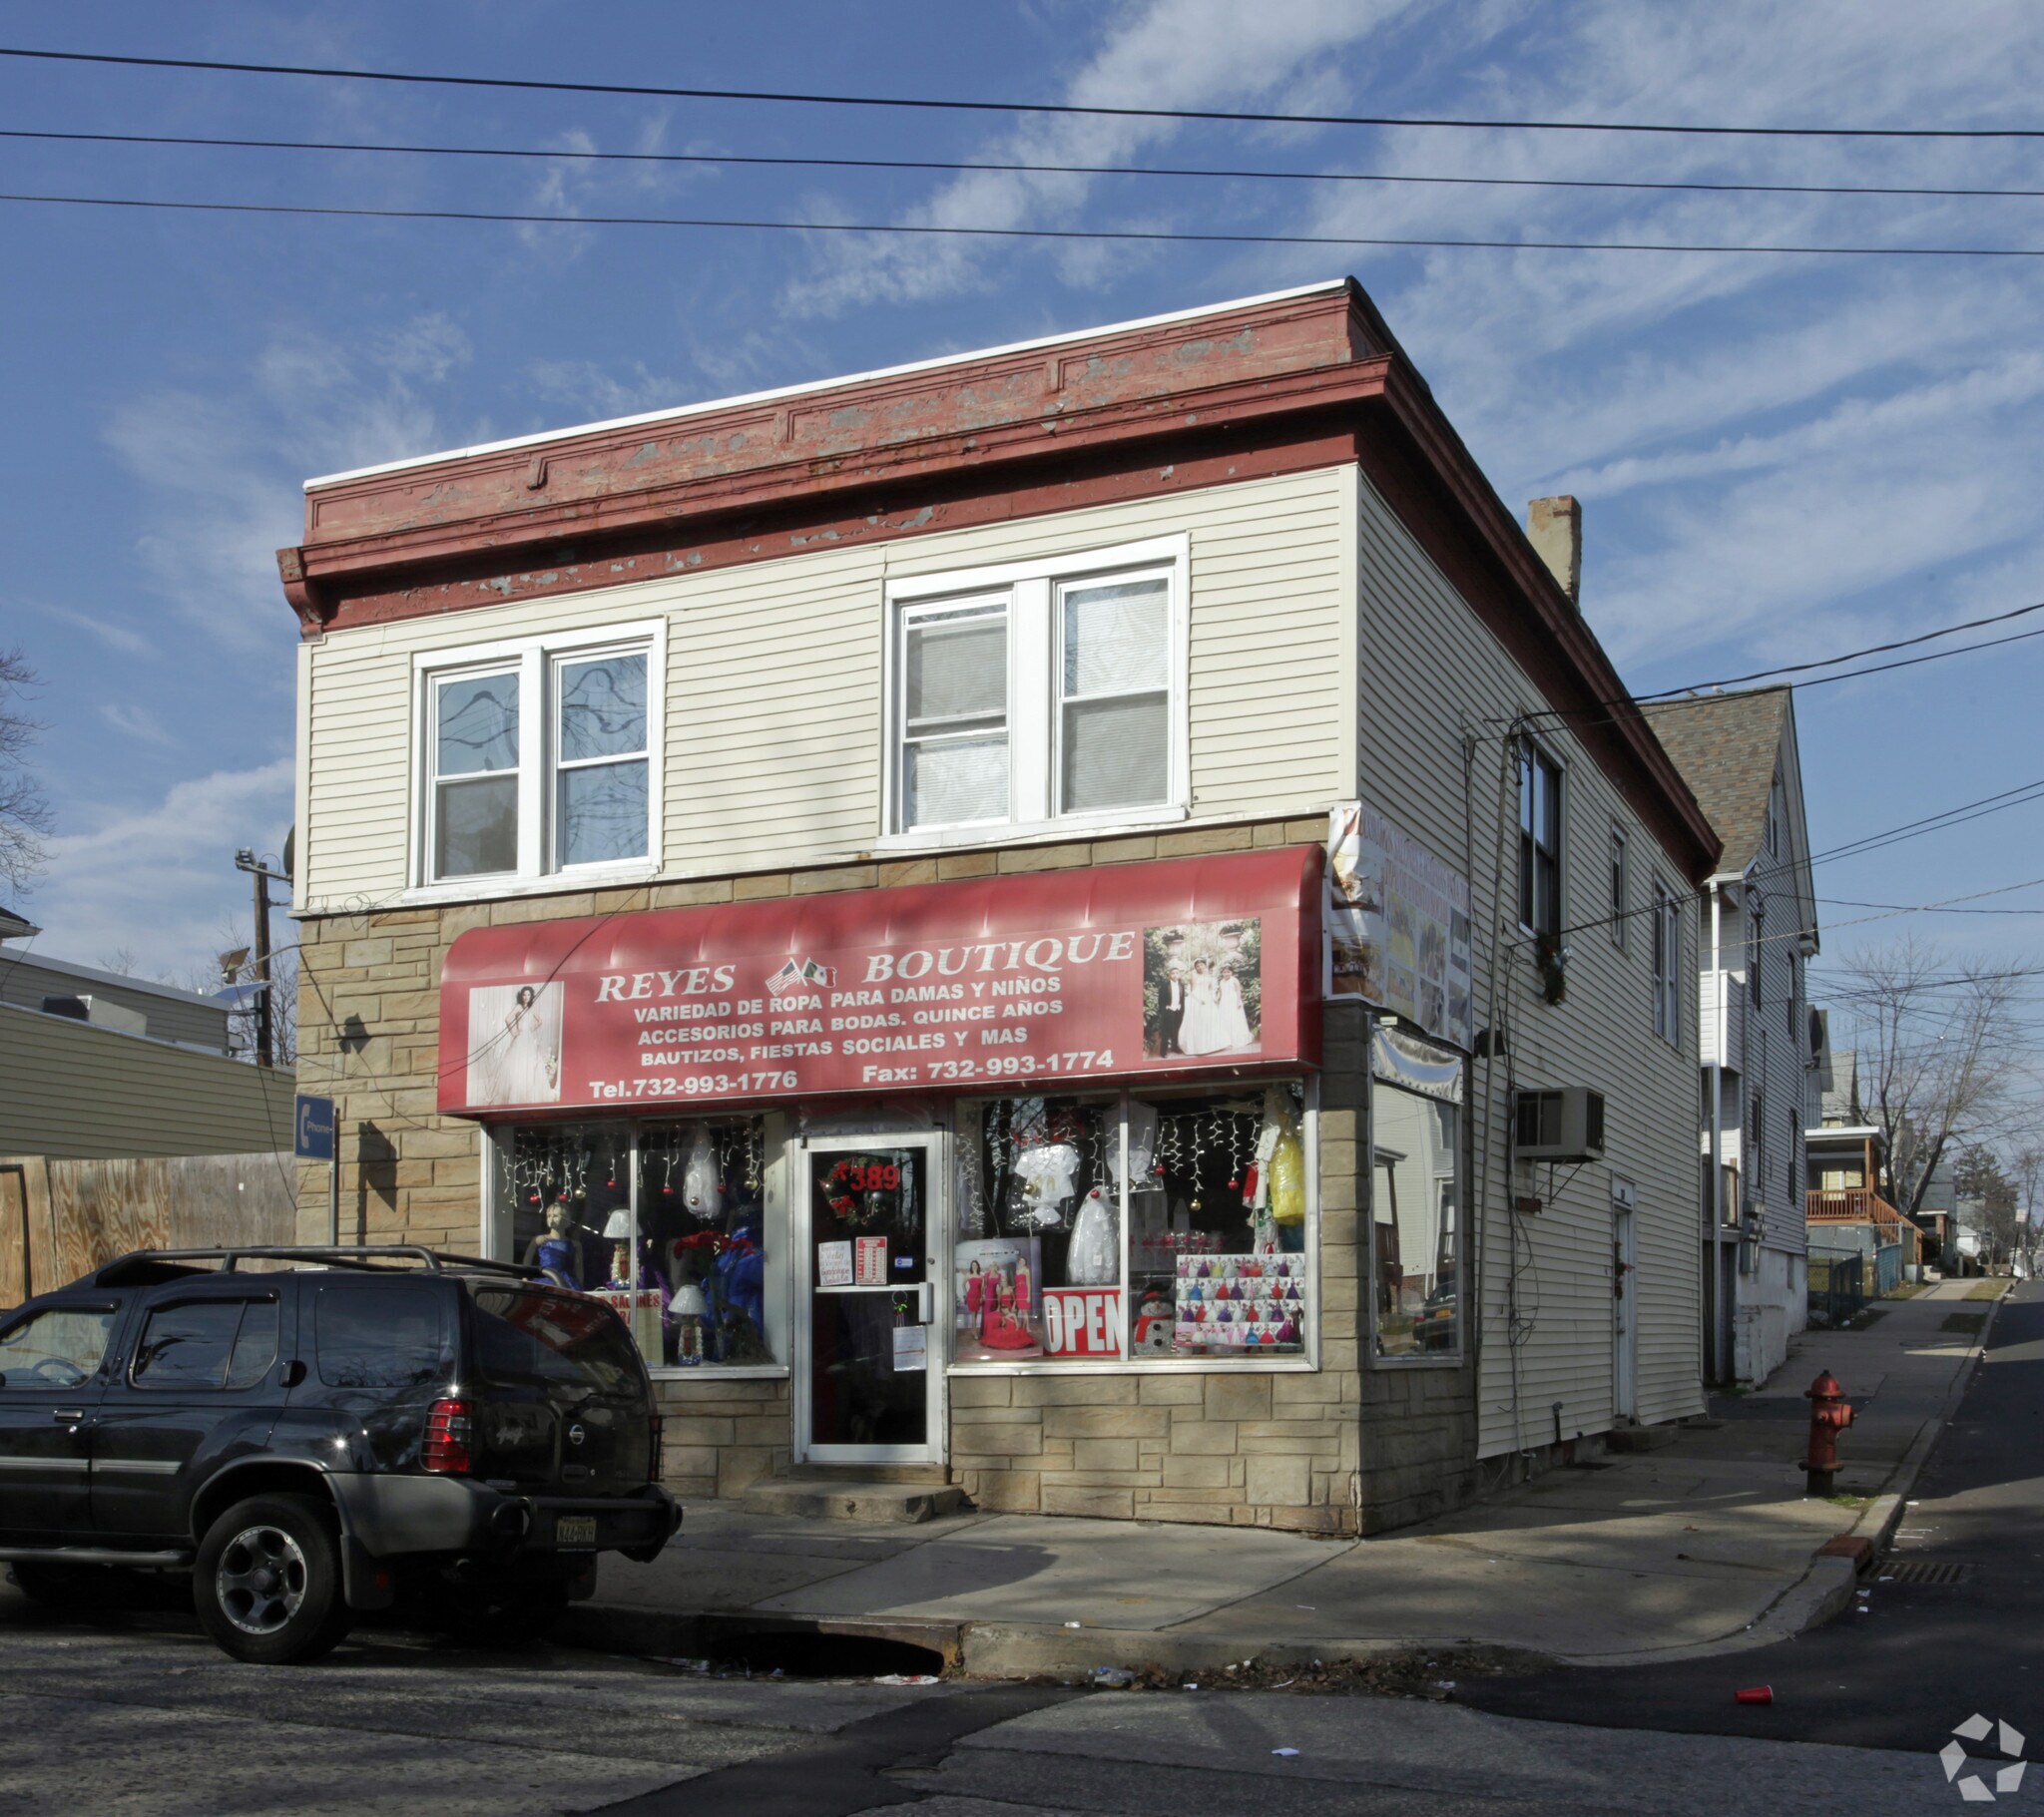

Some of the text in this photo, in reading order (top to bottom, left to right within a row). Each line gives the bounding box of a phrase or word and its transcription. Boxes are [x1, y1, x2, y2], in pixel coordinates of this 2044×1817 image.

[595, 931, 1136, 1003] REYES BOUTIQUE
[634, 975, 1061, 1023] VARIEDAD DE ROPA PARA DAMAS Y NIÑOS
[638, 1000, 1063, 1045] ACCESORIOS PARA BODAS. QUINCE AÑOS
[641, 1027, 1028, 1067] BAUTIZOS, FIESTAS SOCIALES Y MAS
[862, 1064, 917, 1083] Fax:
[927, 1050, 1114, 1079] 732-993-1774
[307, 1121, 330, 1134] Phone
[850, 1164, 899, 1190] 389
[611, 1294, 660, 1309] SALNES
[1043, 1294, 1120, 1353] OPEN
